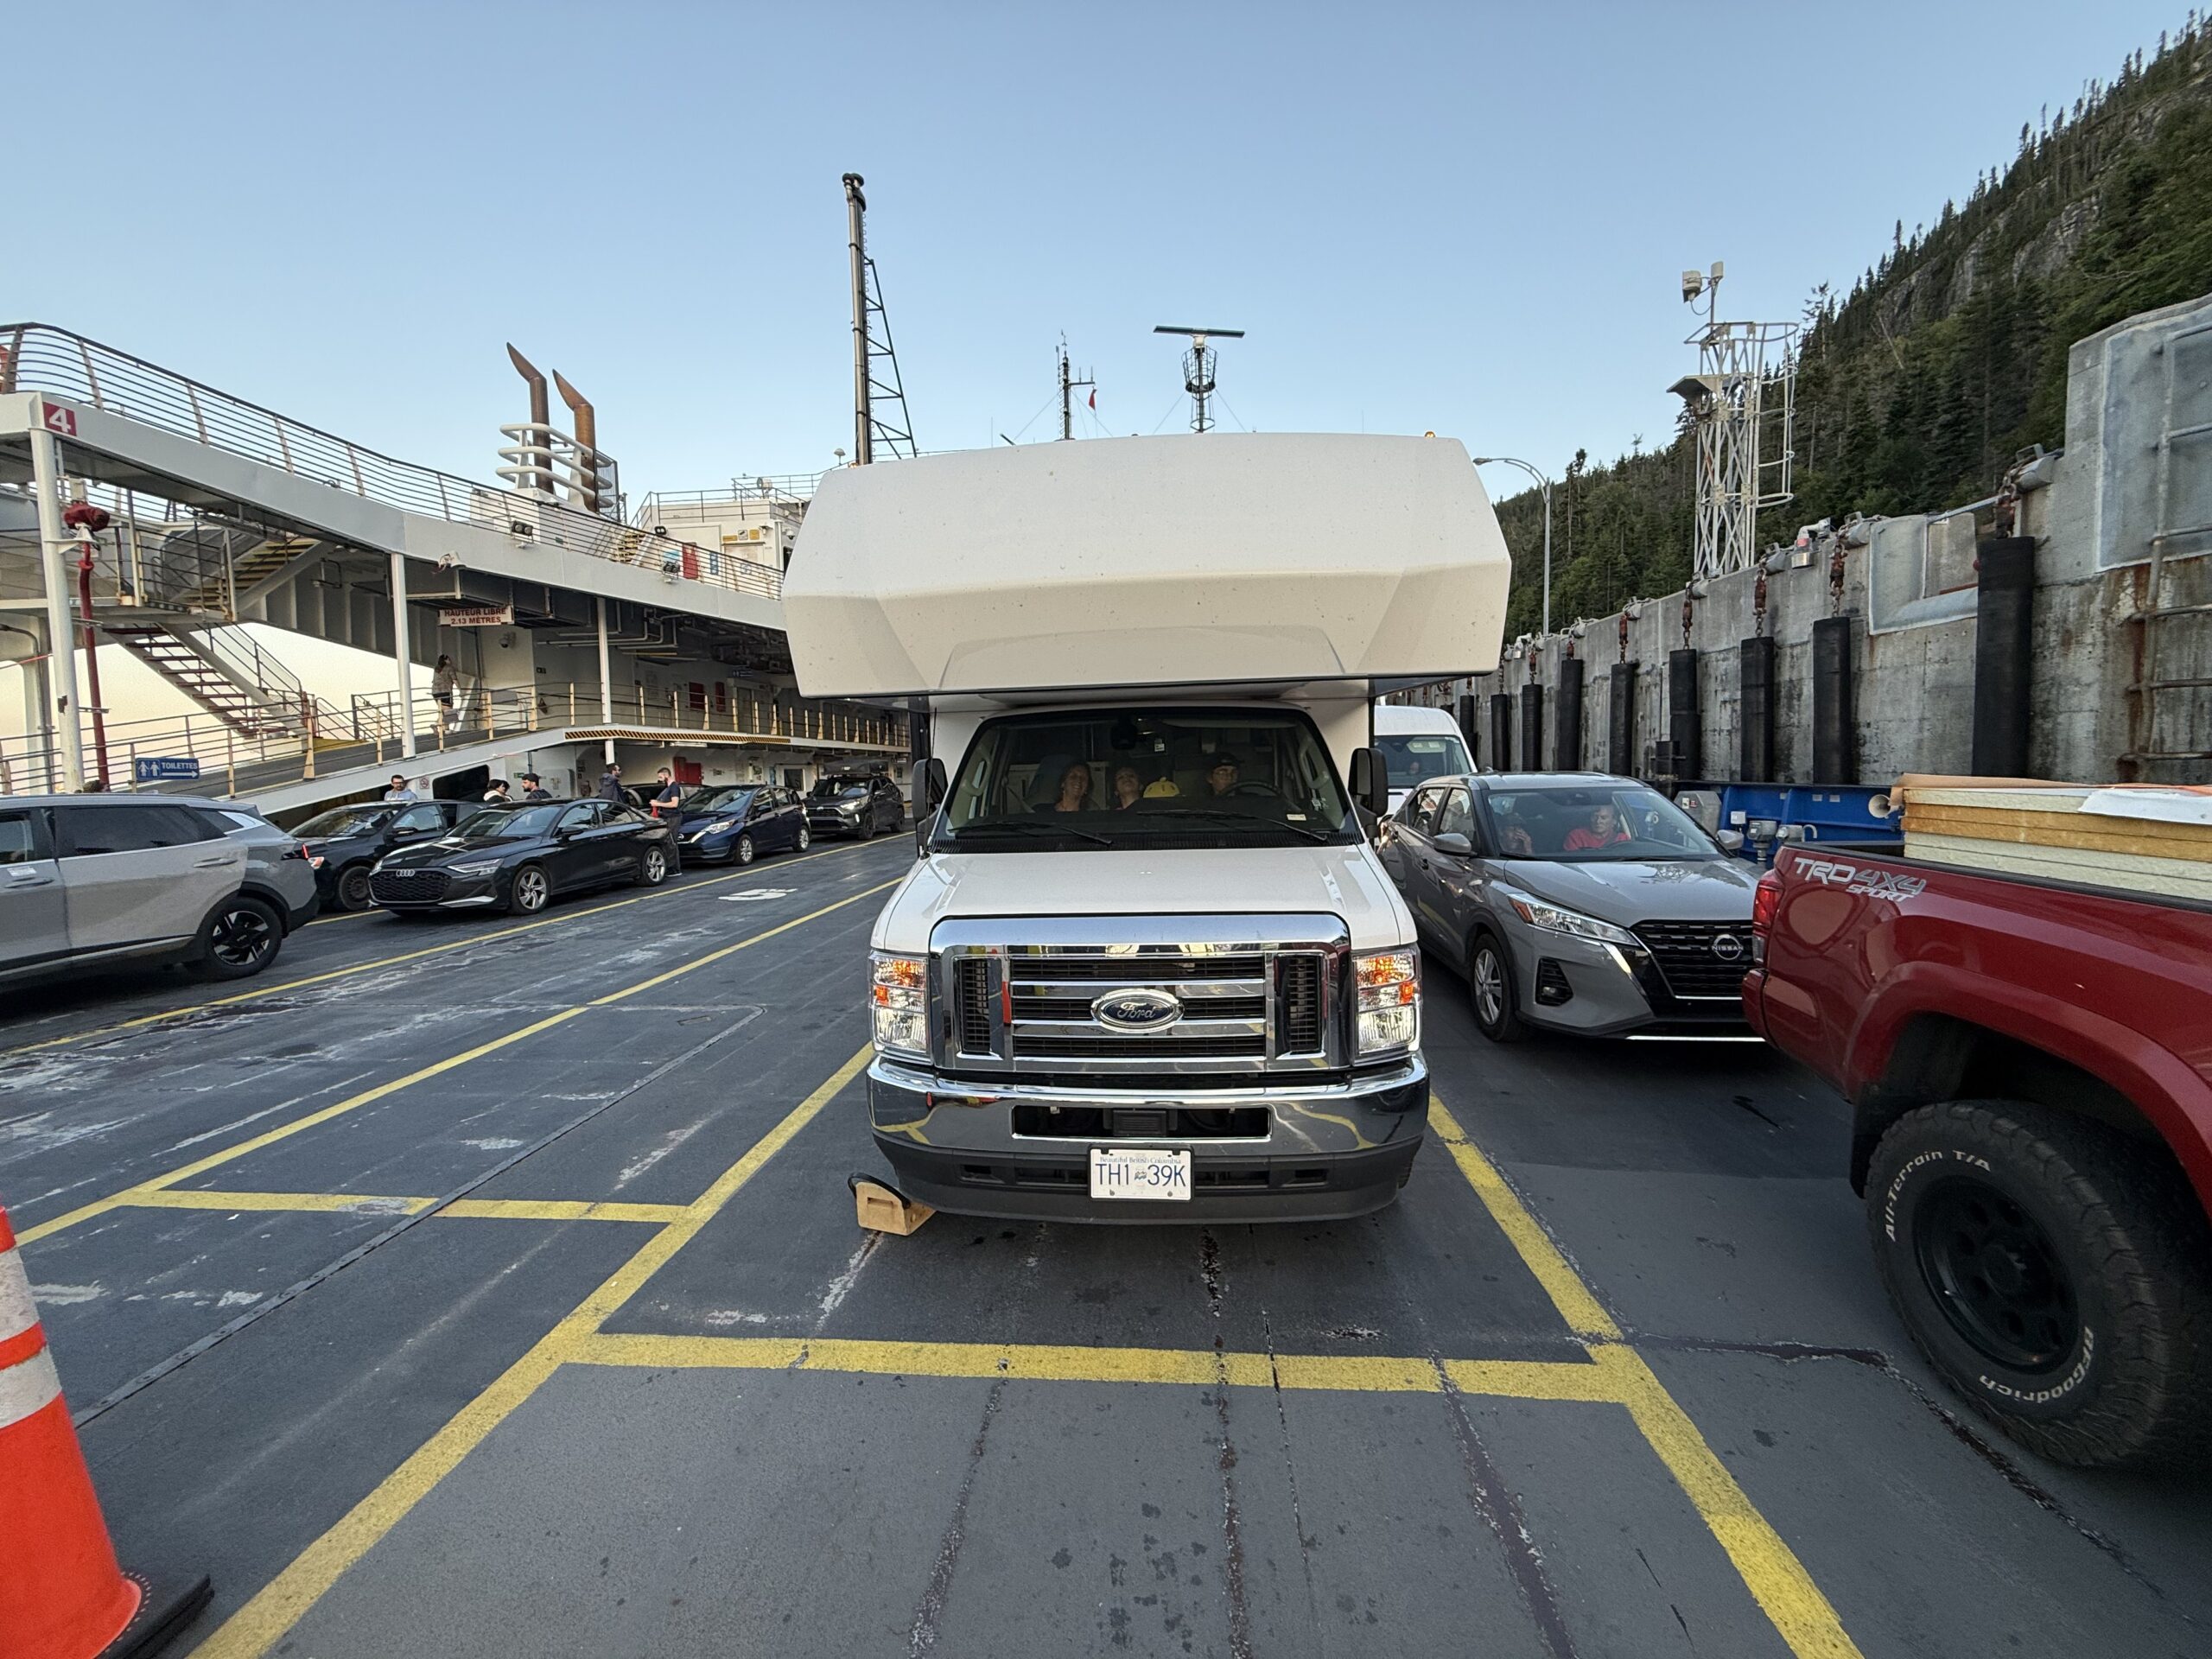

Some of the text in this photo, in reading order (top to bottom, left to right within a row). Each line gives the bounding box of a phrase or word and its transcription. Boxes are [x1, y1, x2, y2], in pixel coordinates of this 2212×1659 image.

[49, 408, 71, 433] 4
[444, 608, 481, 617] HAUTEUR
[1794, 857, 1927, 895] TRD 4X4
[1846, 884, 1915, 902] SPORT
[1117, 1002, 1156, 1019] Ford
[1885, 1151, 1943, 1242] All-Terrain
[1979, 1325, 2094, 1404] BFGoodrich
